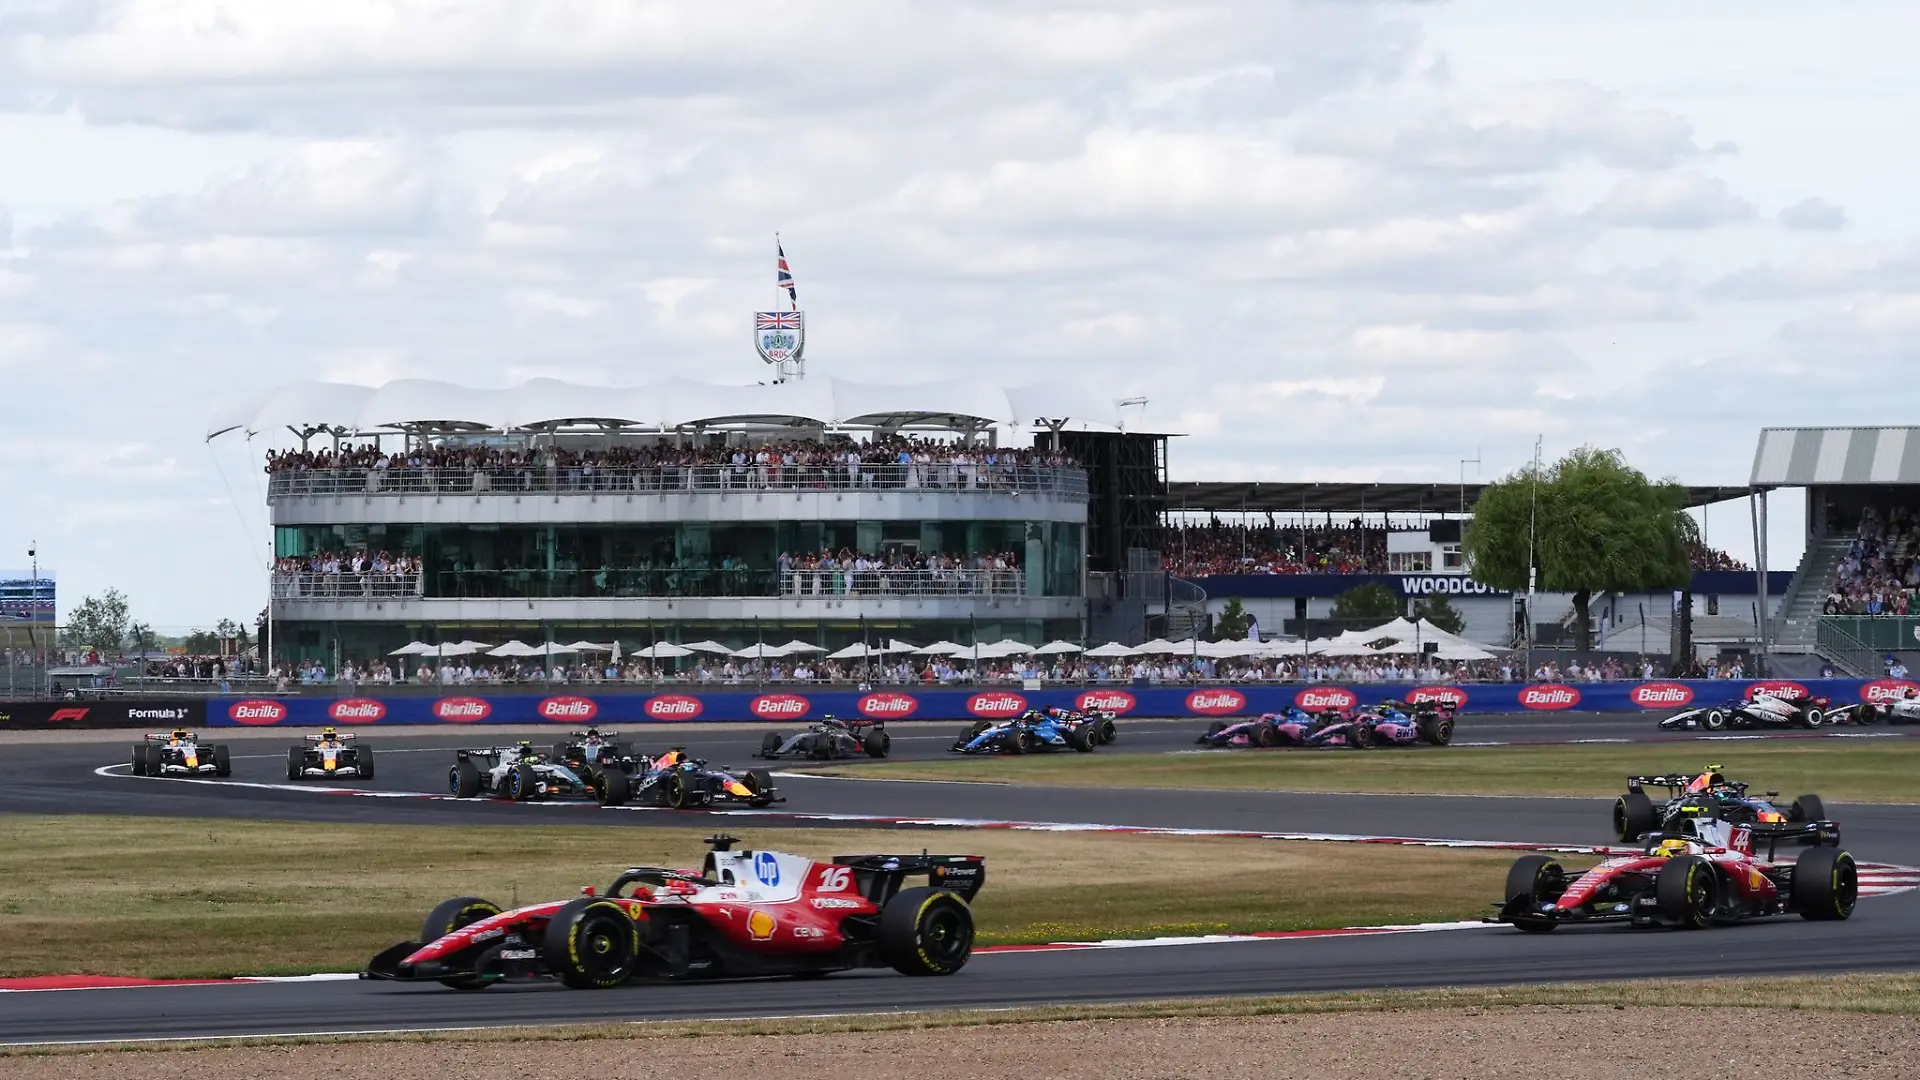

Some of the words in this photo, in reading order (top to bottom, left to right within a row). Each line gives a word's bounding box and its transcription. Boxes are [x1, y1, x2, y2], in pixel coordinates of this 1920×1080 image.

[1402, 577, 1509, 594] WOODCO
[1526, 691, 1571, 703] Barilla
[1638, 689, 1683, 701] Barilla
[1867, 685, 1908, 699] Barill
[865, 699, 909, 711] Barilla
[974, 698, 1018, 710] Barilla
[1083, 696, 1127, 708] Barilla
[1192, 695, 1237, 707] Barilla
[1303, 694, 1348, 705] Barilla
[236, 706, 278, 717] Barilla
[336, 704, 378, 716] Barilla
[440, 703, 483, 715] Barilla
[546, 702, 588, 714] Barilla
[652, 701, 695, 713] Barilla
[758, 700, 802, 712] Barilla
[48, 708, 90, 721] F1
[128, 708, 176, 719] Formula
[1733, 831, 1749, 850] 44
[759, 851, 777, 887] hp
[816, 867, 851, 892] 16
